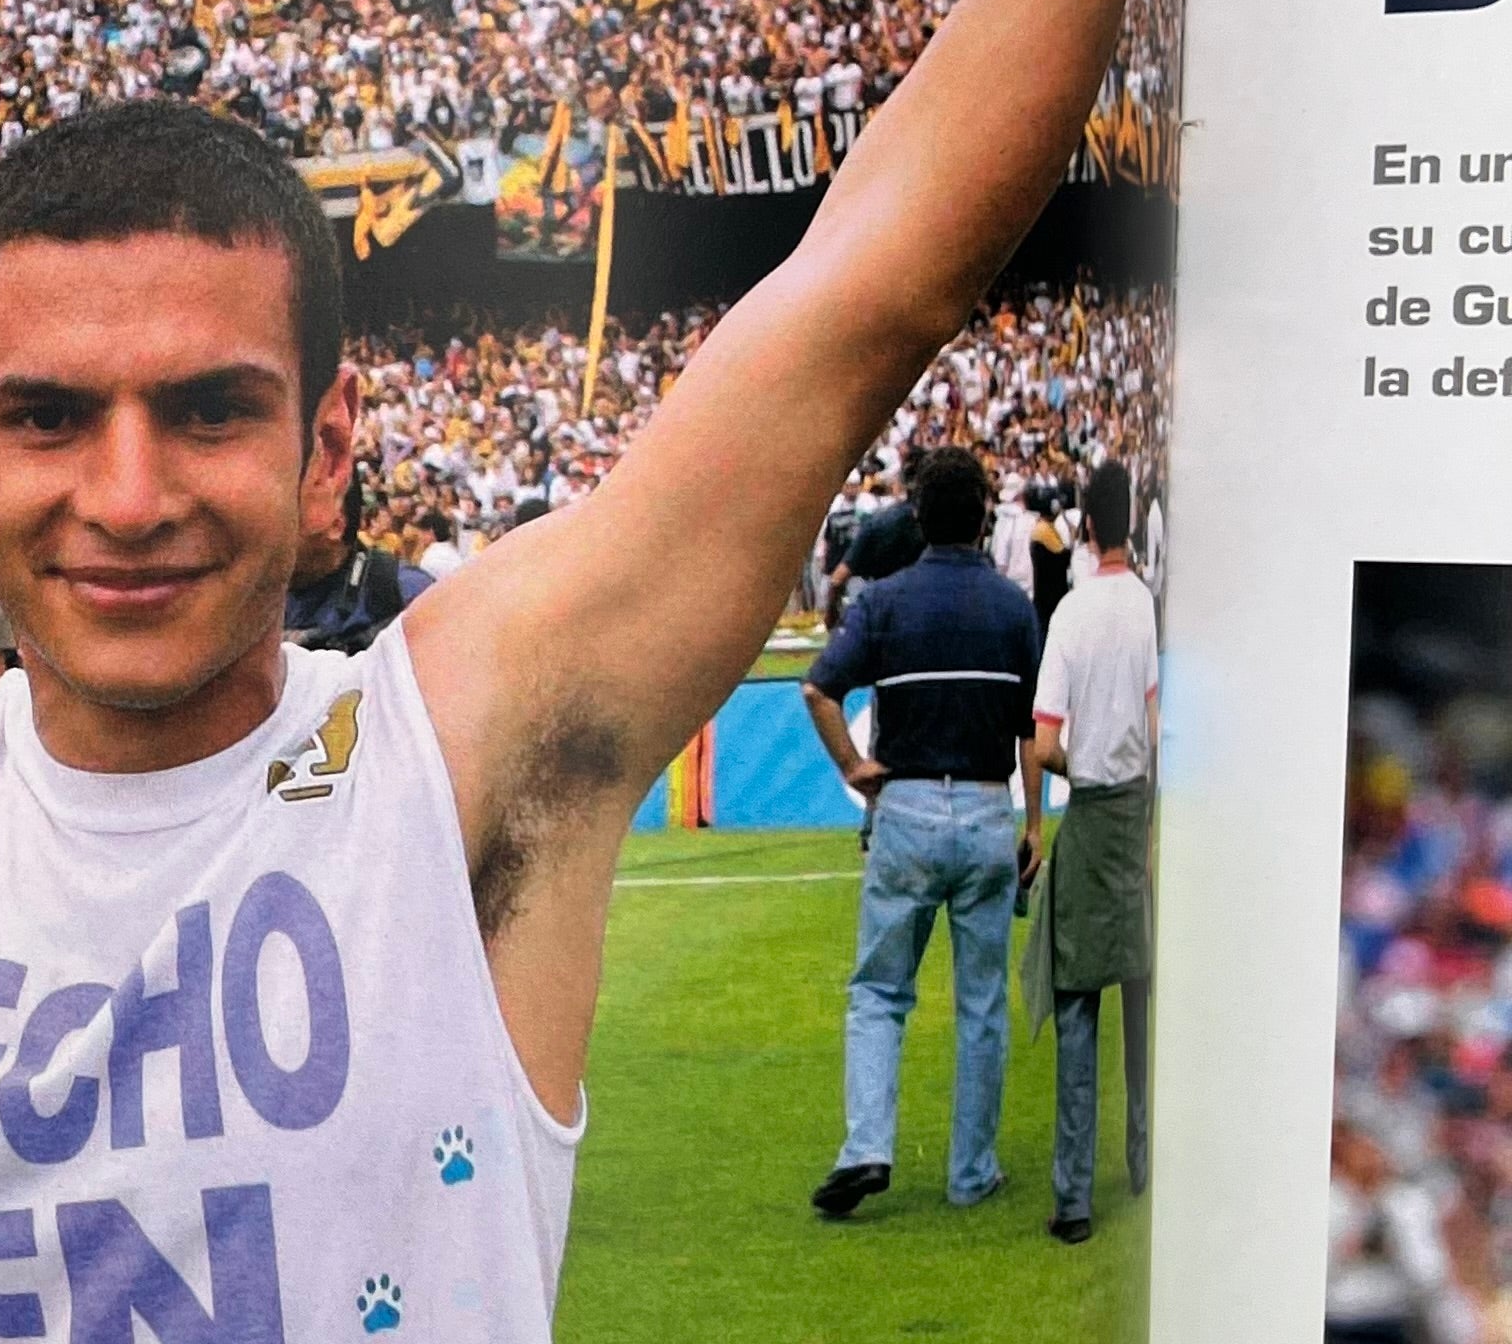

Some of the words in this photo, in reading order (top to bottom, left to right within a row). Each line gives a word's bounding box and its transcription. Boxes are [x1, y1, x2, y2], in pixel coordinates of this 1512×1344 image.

[1372, 143, 1442, 186] En
[1367, 225, 1434, 257] su
[1365, 285, 1432, 327] de
[1363, 355, 1410, 397] la
